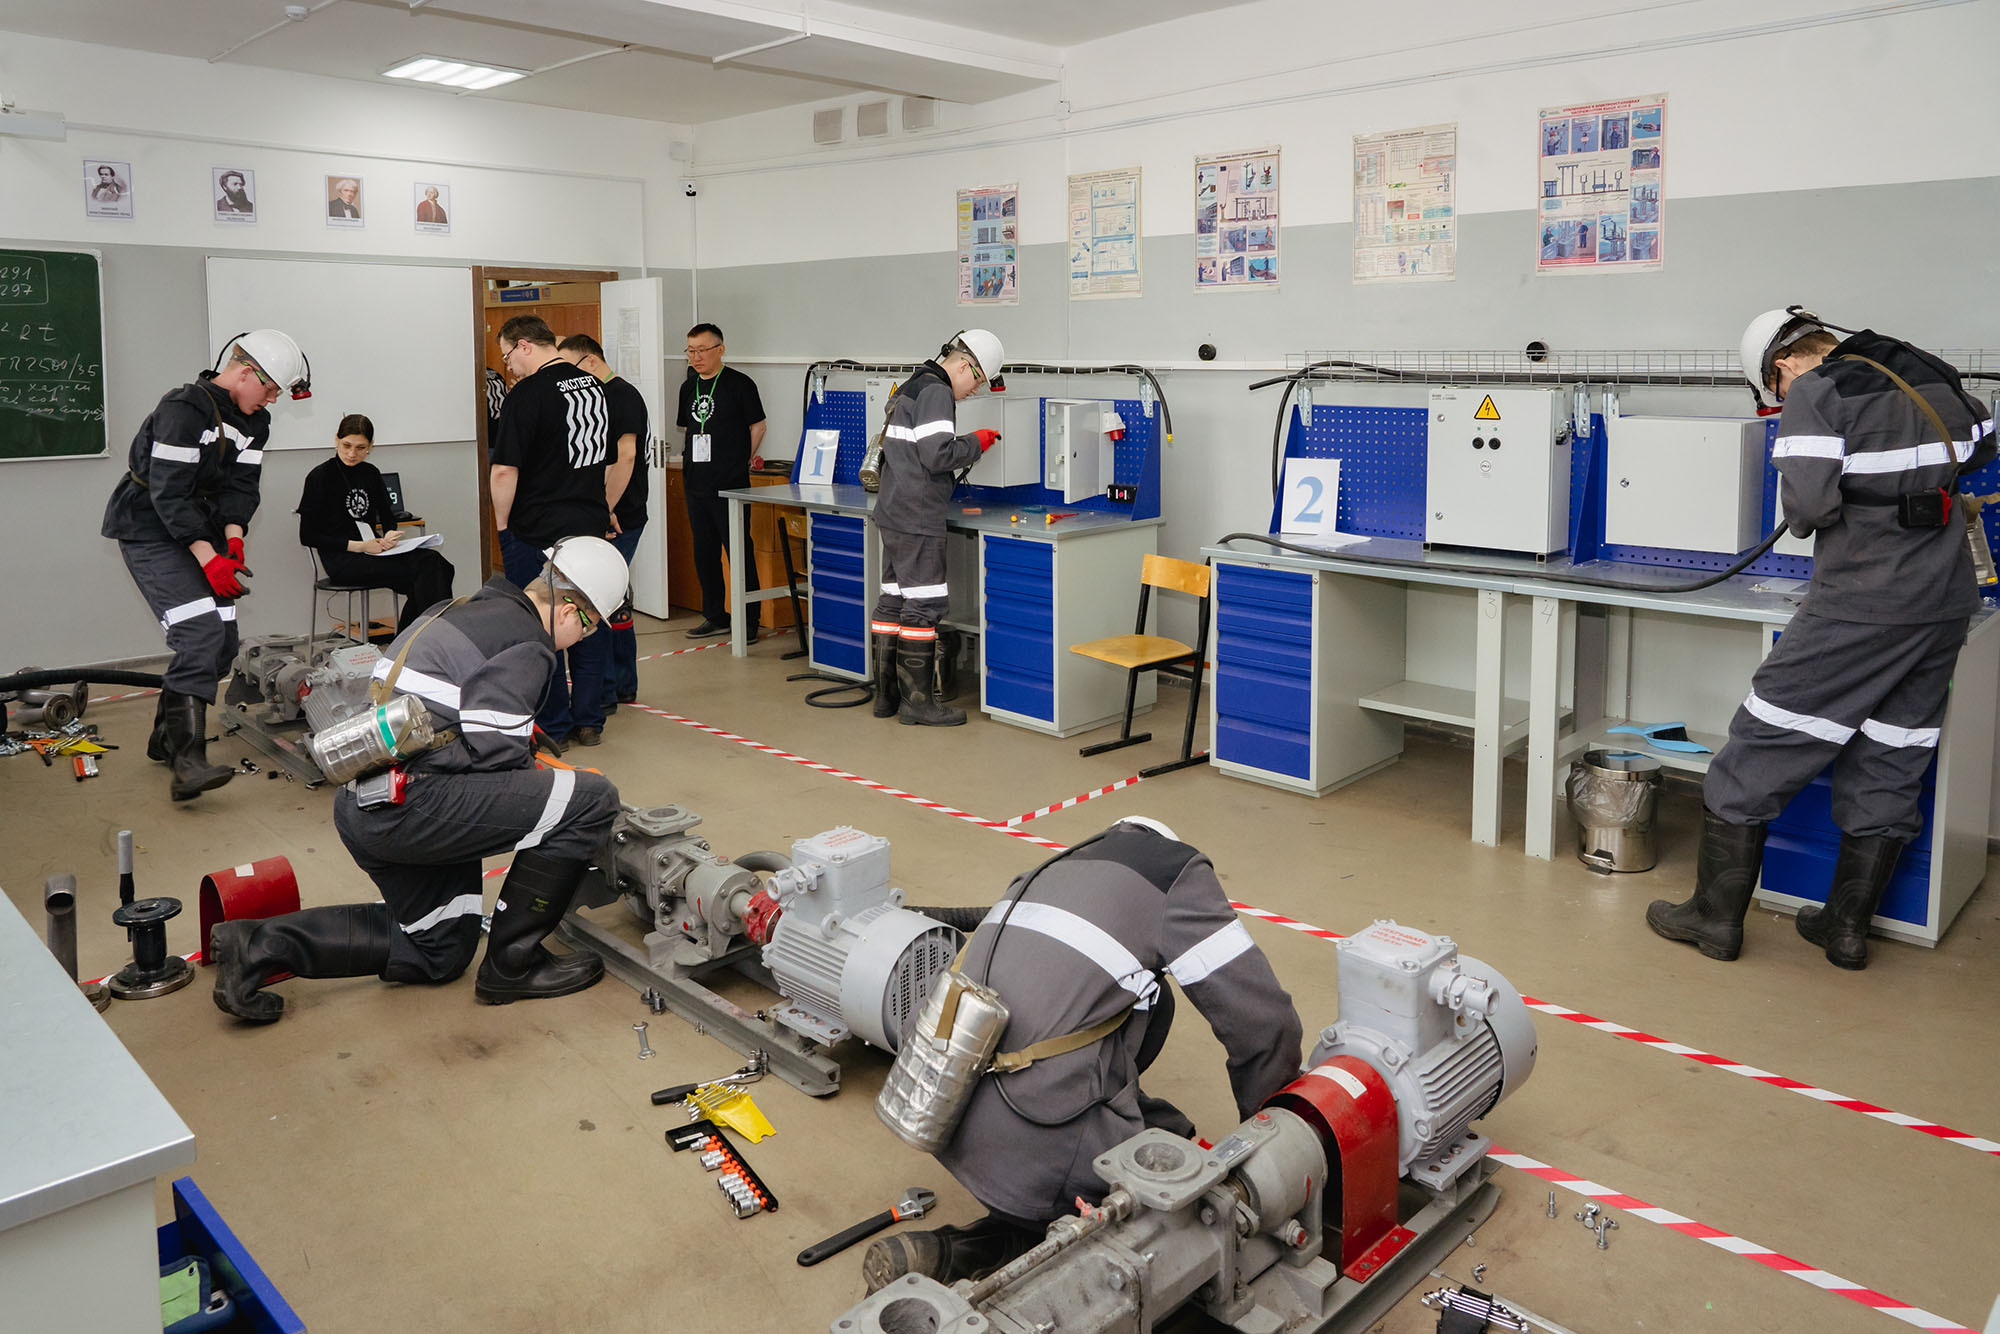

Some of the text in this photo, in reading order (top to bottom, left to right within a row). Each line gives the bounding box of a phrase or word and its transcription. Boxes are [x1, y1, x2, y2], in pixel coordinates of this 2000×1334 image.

[0, 266, 31, 280] 291
[0, 283, 32, 297] 297
[556, 375, 598, 392] ЭКСПЕРТ
[809, 442, 825, 476] 1
[1293, 476, 1323, 523] 2
[1484, 597, 1497, 619] 3
[1541, 604, 1554, 624] 4
